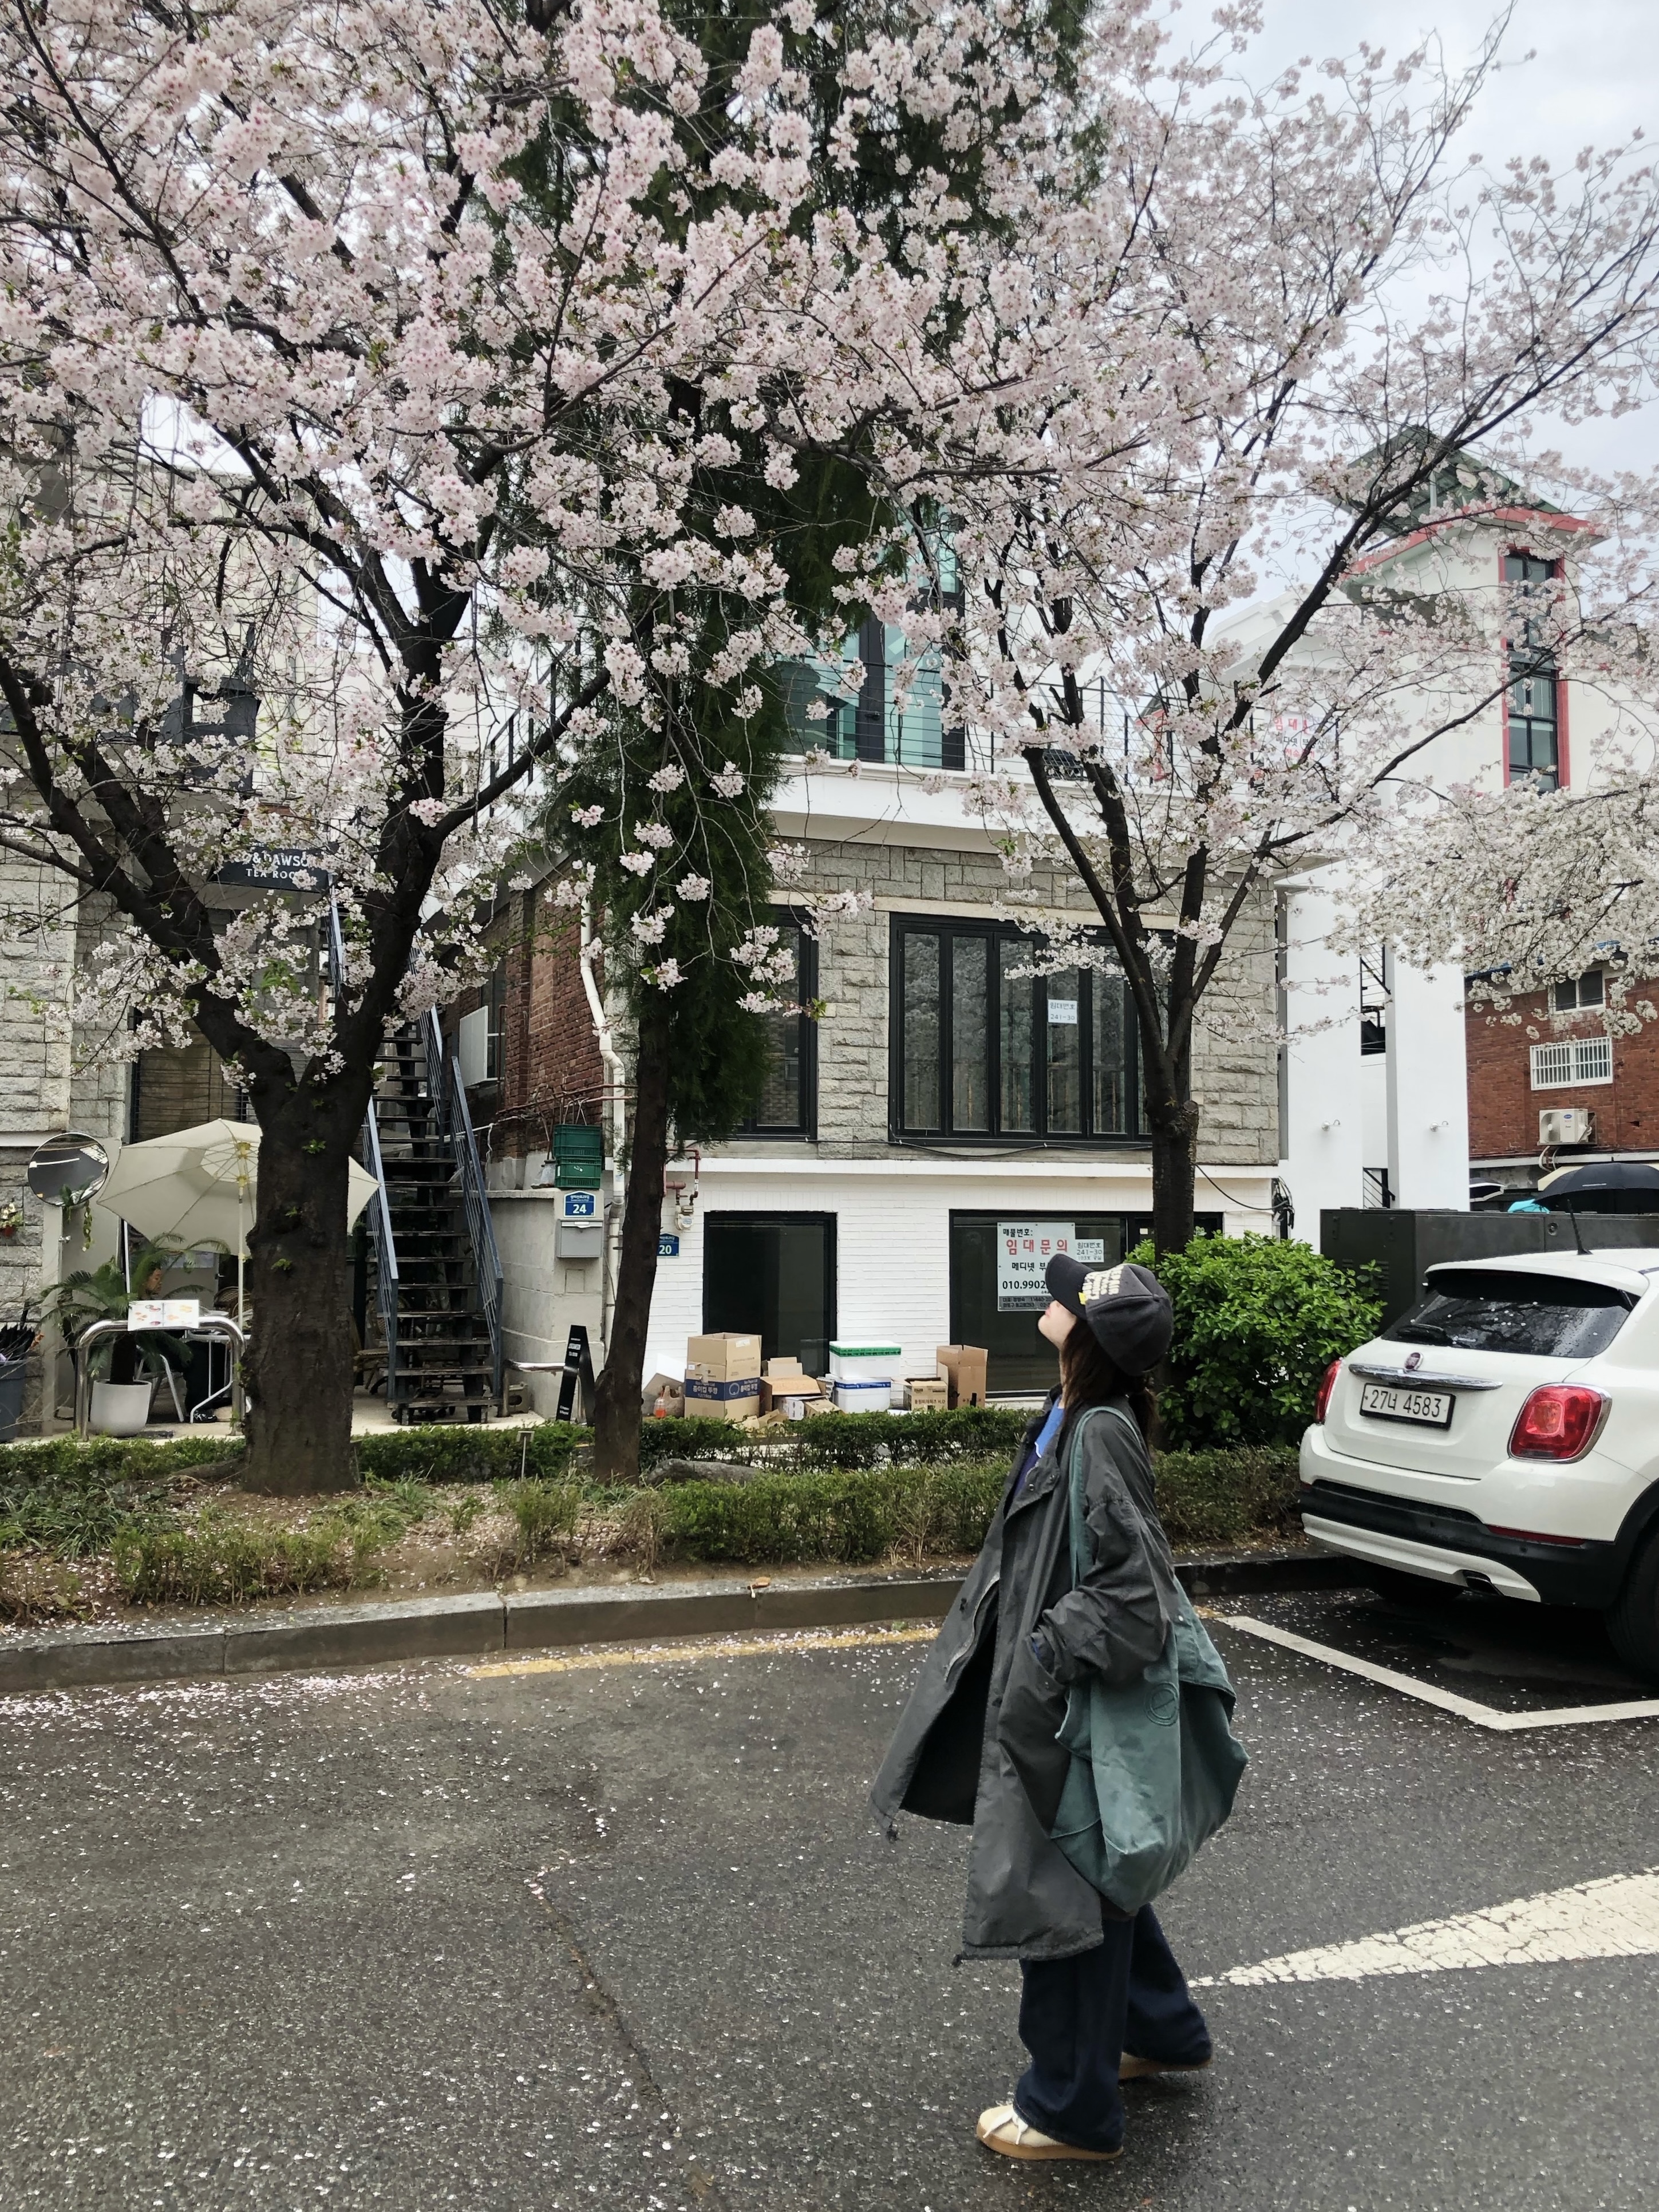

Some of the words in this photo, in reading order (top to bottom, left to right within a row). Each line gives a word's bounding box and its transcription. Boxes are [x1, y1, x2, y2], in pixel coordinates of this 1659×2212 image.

[263, 853, 309, 867] DAWSO
[246, 868, 267, 878] TEA
[272, 870, 296, 879] ROO
[1050, 1002, 1076, 1010] 임대번호
[572, 1204, 587, 1214] 24
[1003, 1228, 1033, 1238] 매물번호:
[659, 1245, 672, 1254] 20
[1012, 1262, 1035, 1272] 메디넷
[1039, 1262, 1049, 1271] 부
[1002, 1281, 1046, 1289] 010.9902
[693, 1385, 707, 1393] 종이컵
[1369, 1389, 1398, 1411] 27너
[1403, 1394, 1441, 1418] 4583
